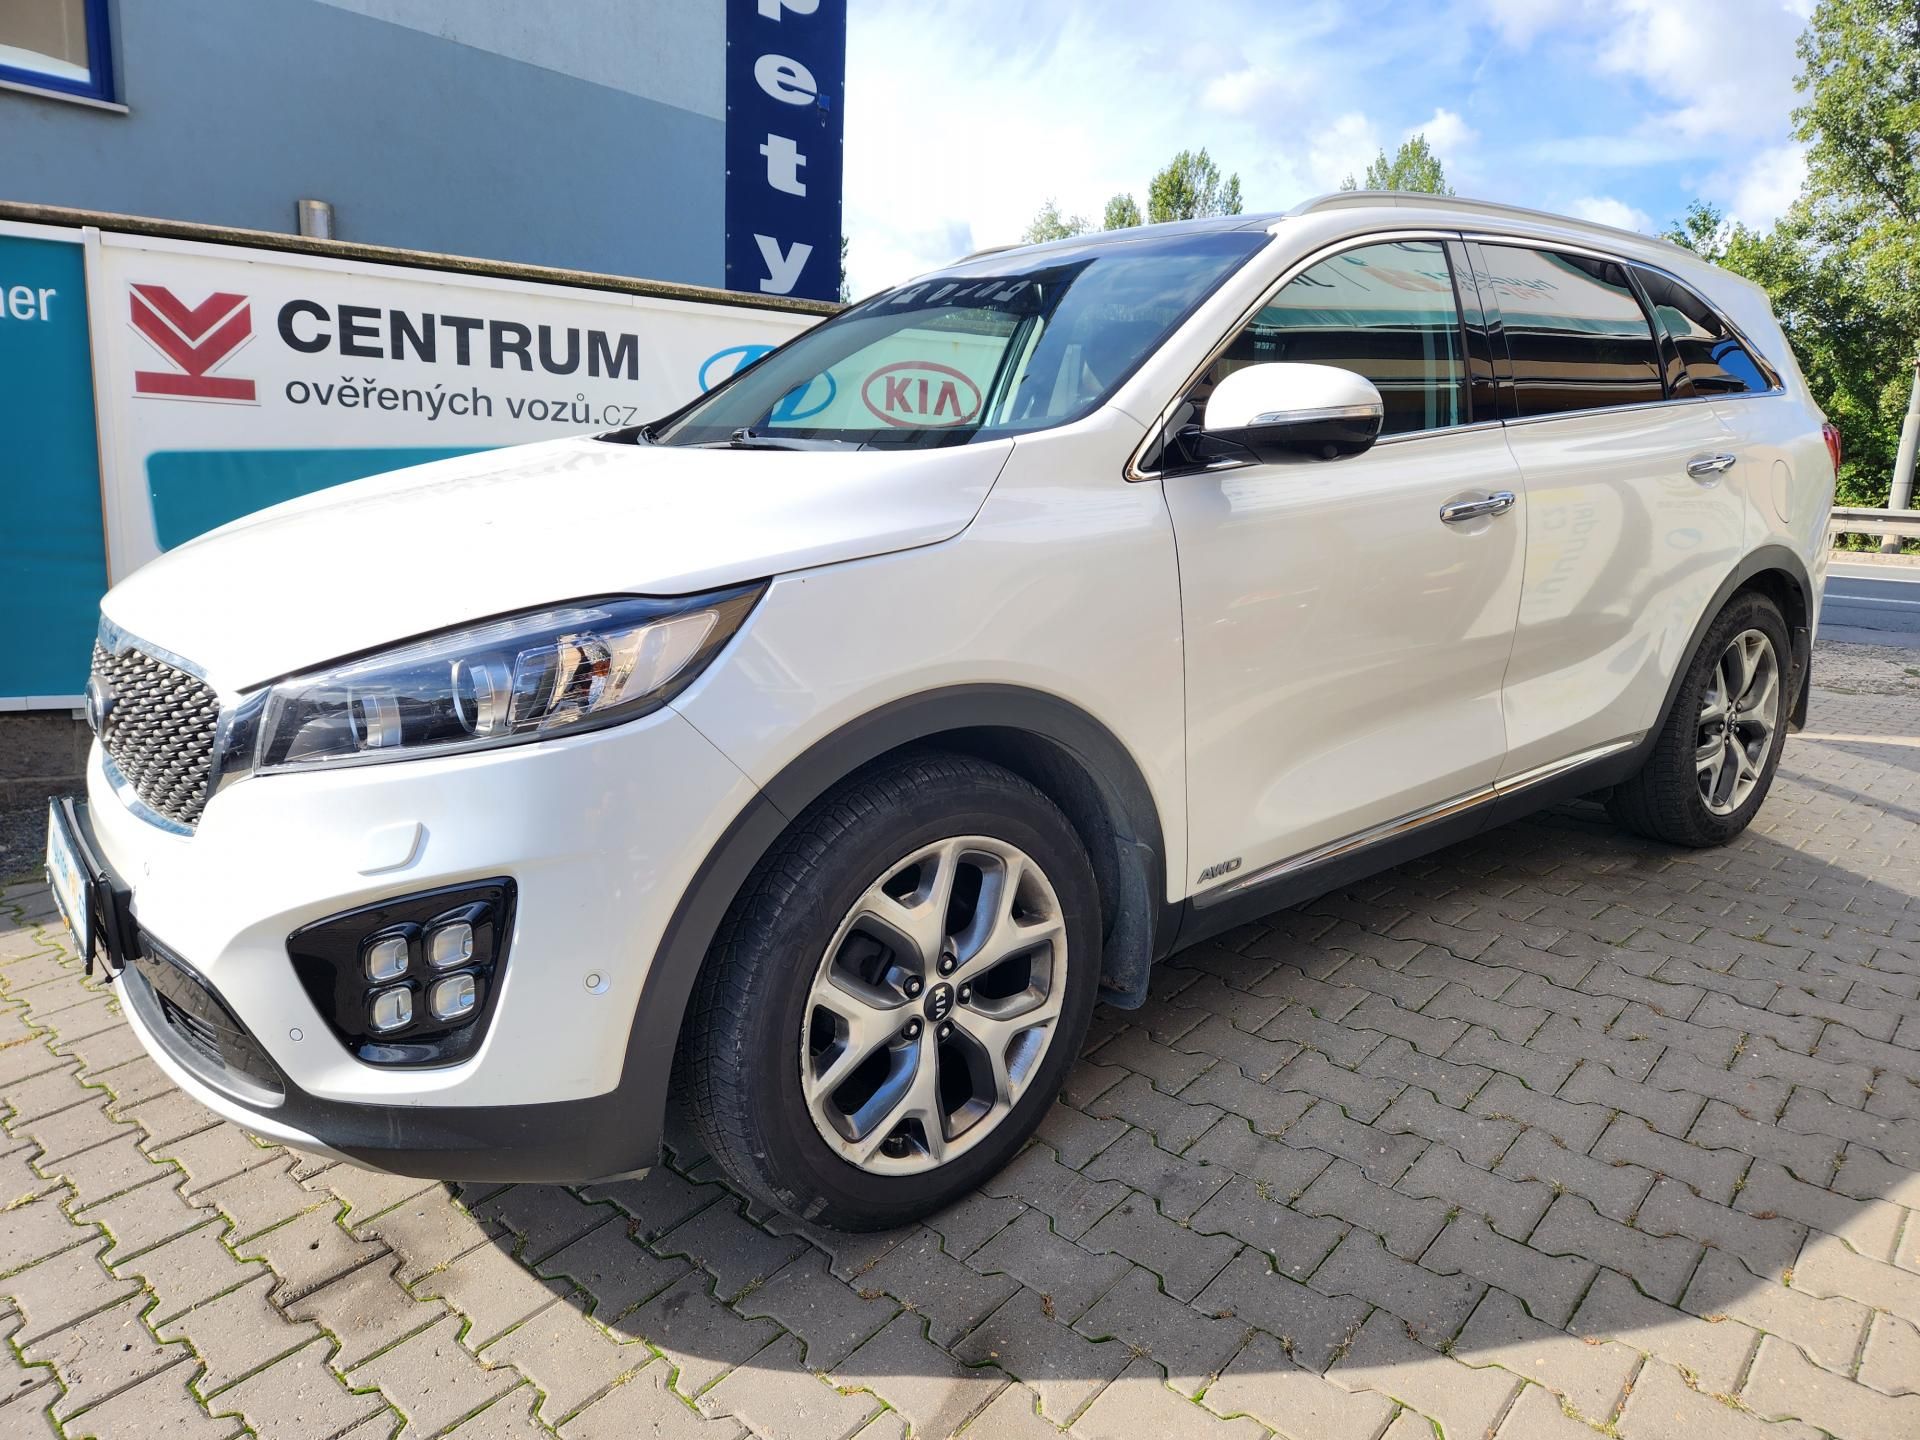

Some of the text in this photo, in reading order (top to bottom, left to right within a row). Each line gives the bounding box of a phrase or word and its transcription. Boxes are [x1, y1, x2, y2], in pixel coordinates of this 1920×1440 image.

[0, 285, 56, 321] er
[278, 300, 639, 380] CENTRUM
[285, 375, 639, 427] ověřených vozů.cz
[885, 376, 962, 417] KIA
[1197, 857, 1242, 884] AWD
[935, 987, 946, 1020] KIA
